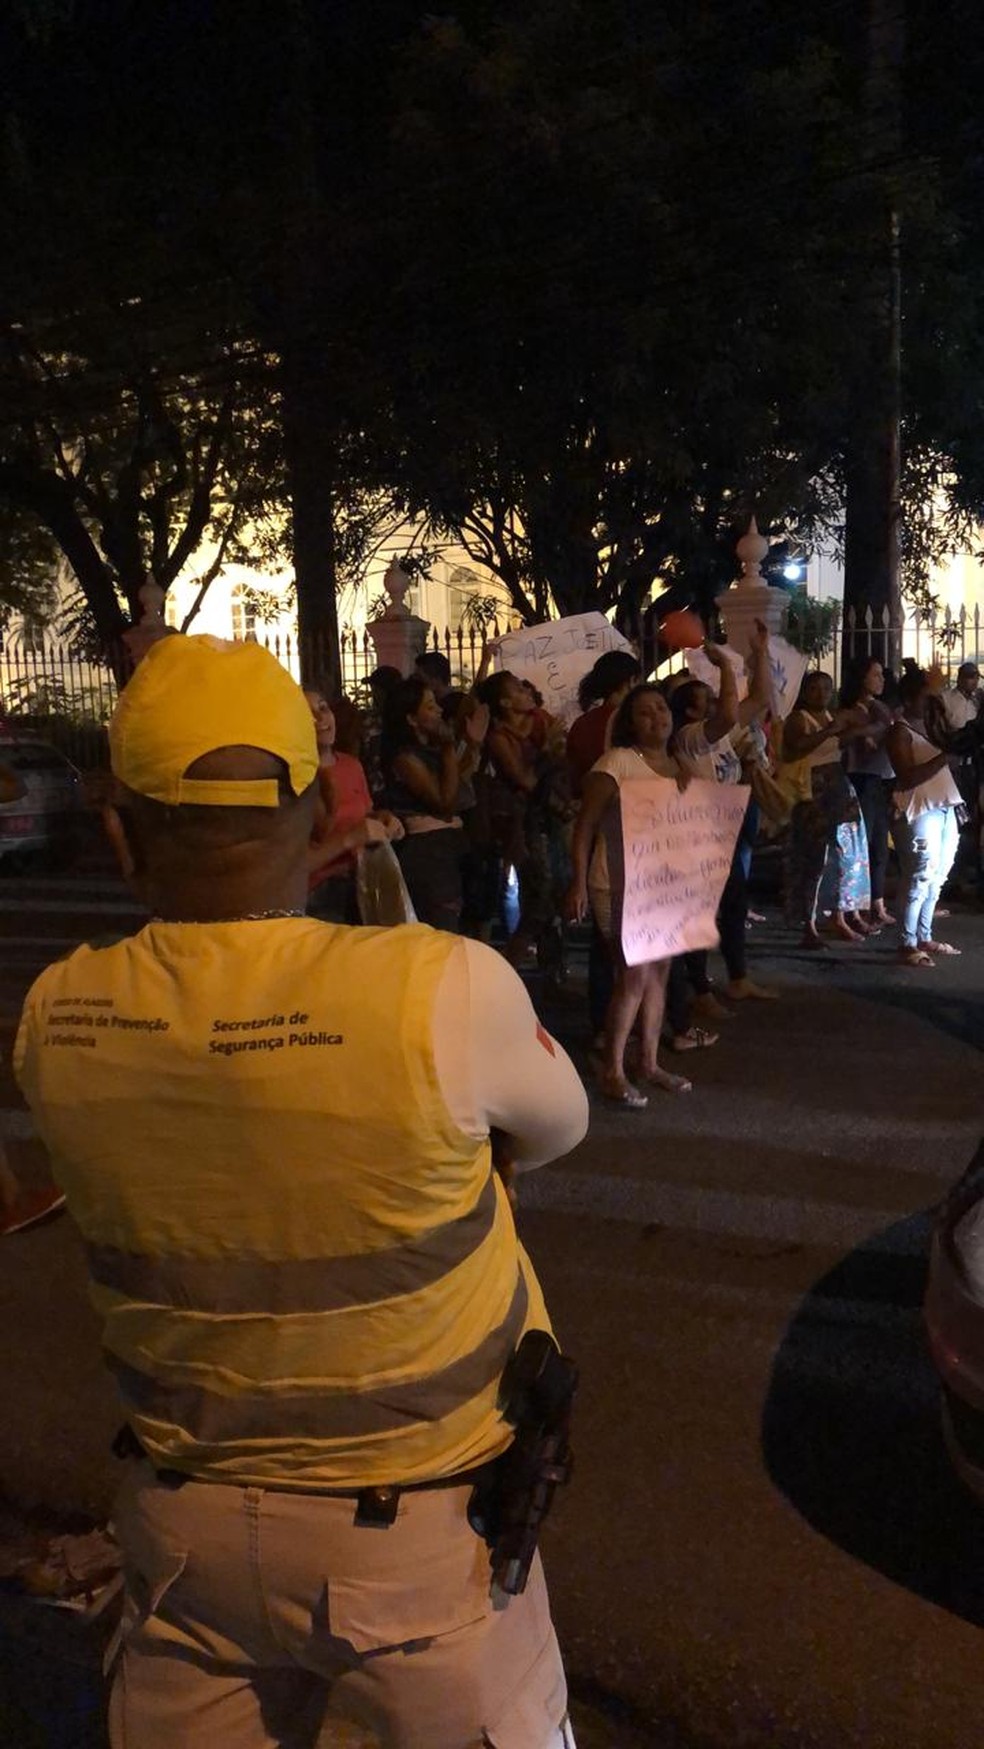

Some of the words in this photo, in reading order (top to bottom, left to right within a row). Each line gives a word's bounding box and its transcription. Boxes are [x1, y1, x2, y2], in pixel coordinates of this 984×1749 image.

[95, 1014, 109, 1027] de
[111, 1015, 170, 1033] Prevenção
[212, 1013, 285, 1032] Secretaria
[289, 1011, 309, 1025] de
[209, 1037, 284, 1056] Segurança
[289, 1031, 343, 1047] Pública
